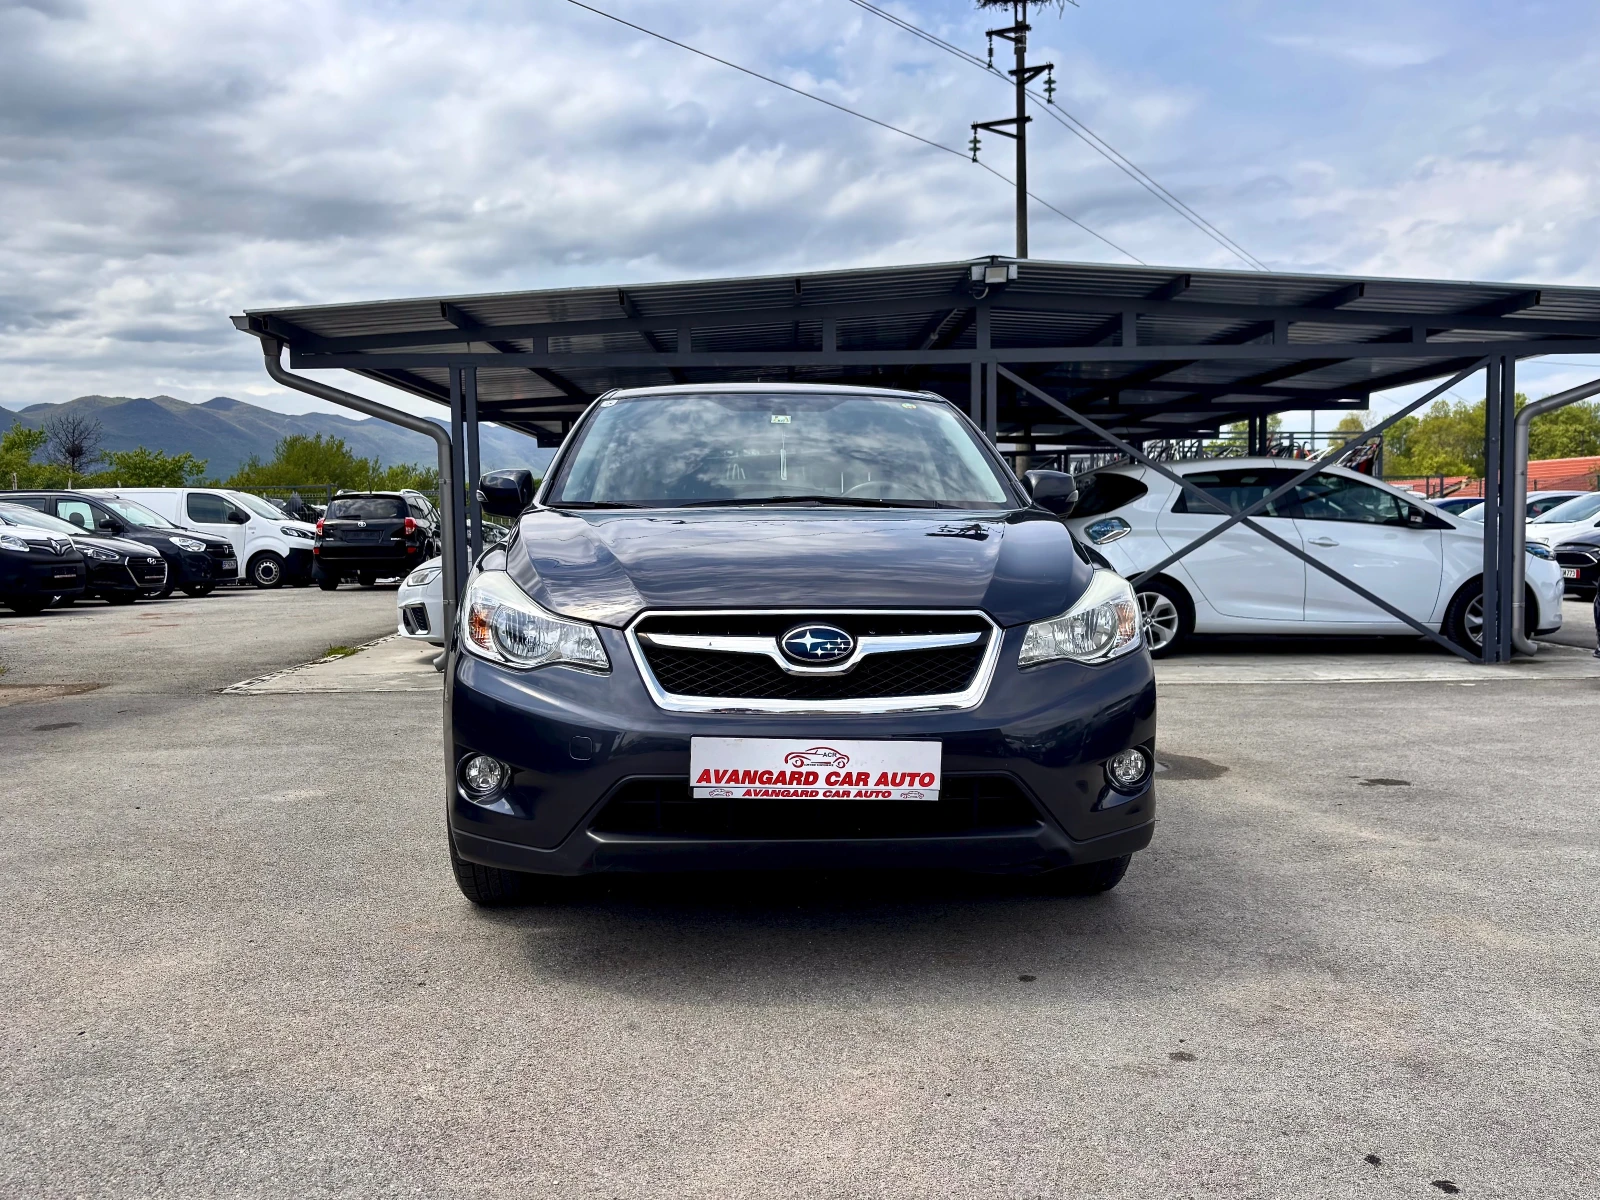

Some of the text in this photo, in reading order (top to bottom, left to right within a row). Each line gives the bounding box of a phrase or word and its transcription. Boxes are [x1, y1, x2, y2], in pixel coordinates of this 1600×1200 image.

[696, 769, 935, 787] AVANGARD CAR AUTO
[742, 789, 892, 798] AVANGARD CAR AUTO
